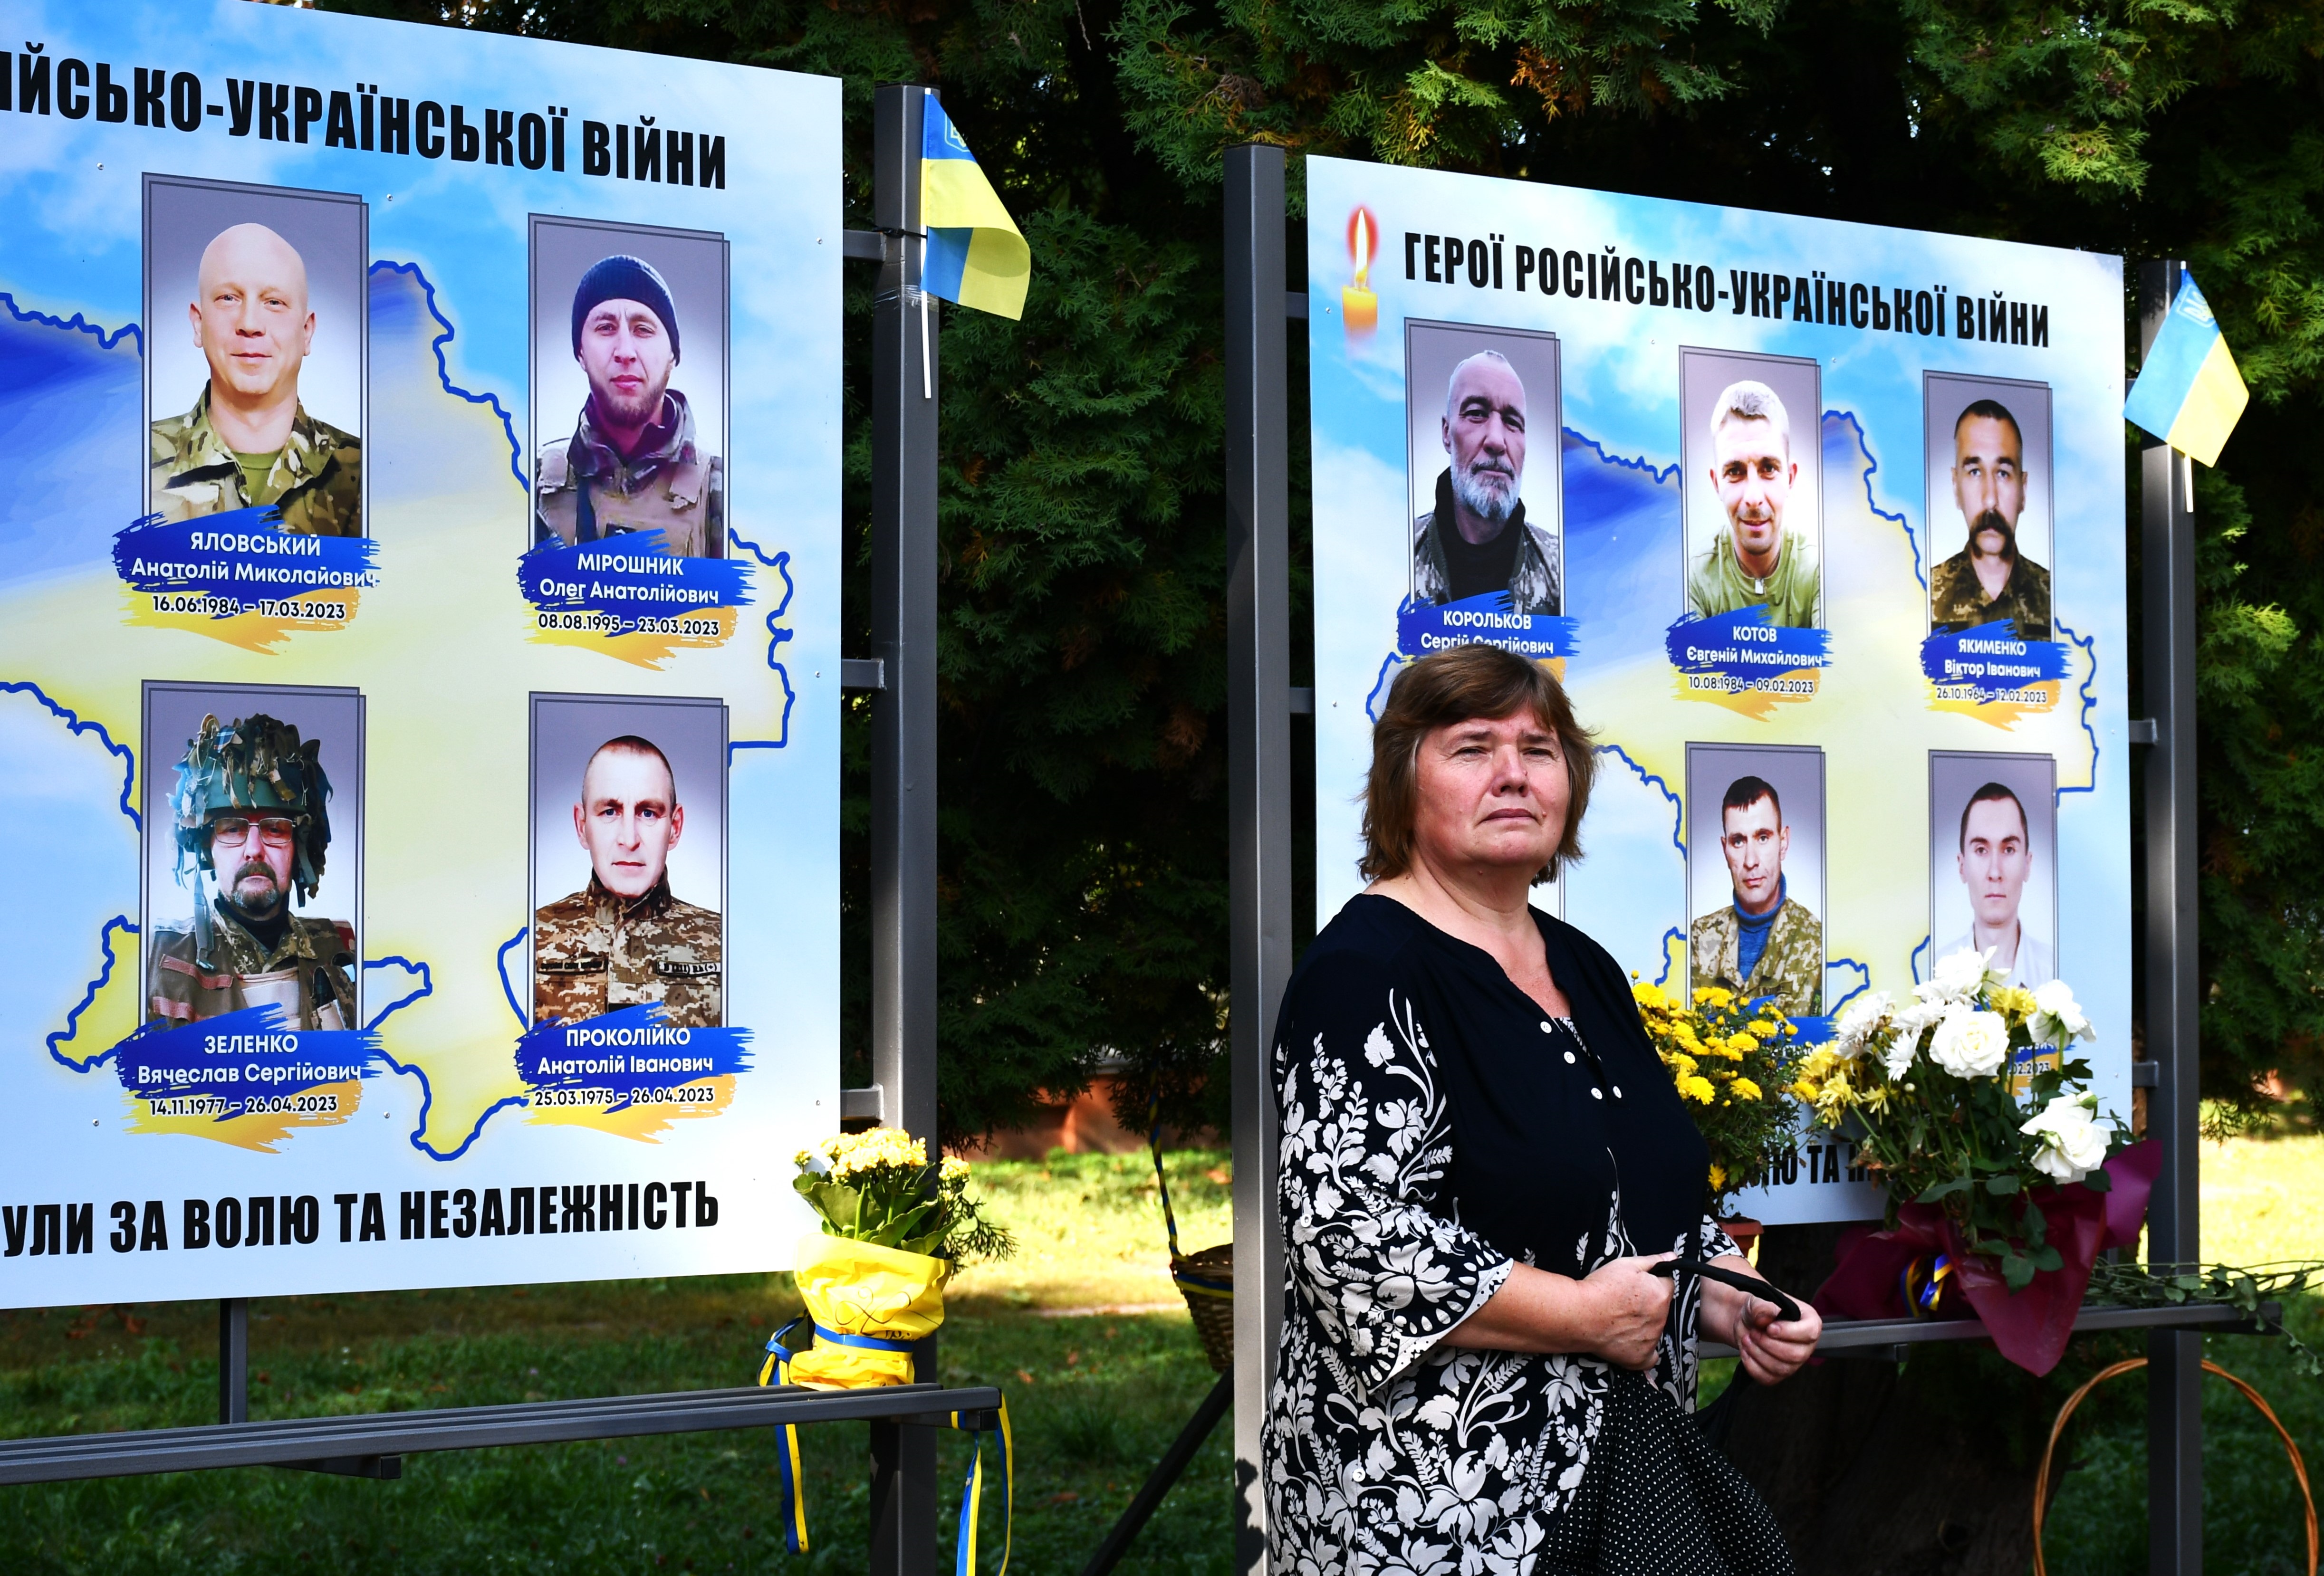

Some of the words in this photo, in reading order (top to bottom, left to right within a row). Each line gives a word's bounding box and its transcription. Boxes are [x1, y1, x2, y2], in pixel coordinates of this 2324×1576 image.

[583, 115, 725, 190] ВІЙНИ
[1405, 232, 1504, 289] ГЕРОЇ
[1516, 245, 1947, 336] РОСІЙСЬКО-УКРАЇНСЬКОЇ
[1957, 291, 2048, 348] ВІЙНИ
[191, 532, 321, 556] ЯЛОВСЬКИЙ
[131, 558, 229, 580] Анатолій
[235, 563, 376, 587] Миколайович
[578, 554, 684, 575] МІРОШНИК
[540, 578, 586, 597] Олег
[590, 581, 719, 604] Анатолійович
[153, 596, 239, 614] 16.06.1984
[260, 601, 345, 619] 17.03.2023
[538, 613, 619, 631] 08.08.1995
[638, 618, 719, 635] 23.03.2023
[1443, 611, 1532, 630] КОРОЛЬКОВ
[1733, 626, 1777, 642] КОТОВ
[1473, 635, 1554, 654] Сргійович
[1959, 639, 2027, 656] ЯКИМЕНКО
[1687, 646, 1738, 663] Євгеній
[1741, 649, 1822, 666] Михайлович
[1944, 659, 1985, 678] Віктор
[1987, 662, 2041, 678] Іванович
[1689, 677, 1743, 690] 10.08.1984
[1757, 679, 1814, 693] 09.02.2023
[1997, 690, 2047, 703] 12.02.2023
[204, 1035, 298, 1054] ЗЕЛЕНКО
[566, 1023, 691, 1047] ПРОКОЛІЙКО
[138, 1065, 239, 1084] Вячеслав
[244, 1061, 361, 1086] Сергійович
[538, 1055, 625, 1074] Анатолій
[631, 1055, 713, 1073] Іванович
[150, 1098, 225, 1116] 14.11.1977
[246, 1096, 337, 1113] 26.04.2023
[535, 1090, 613, 1106] 25.03.1975
[632, 1088, 714, 1104] 26.04.2023
[1807, 1145, 1840, 1184] ТА
[2, 1203, 93, 1257] УЛИ
[110, 1200, 168, 1253] ЗА
[183, 1195, 319, 1249] ВОЛЮ
[334, 1193, 386, 1242] ТА
[400, 1181, 718, 1240] НЕЗАЛЕЖНІСТЬ
